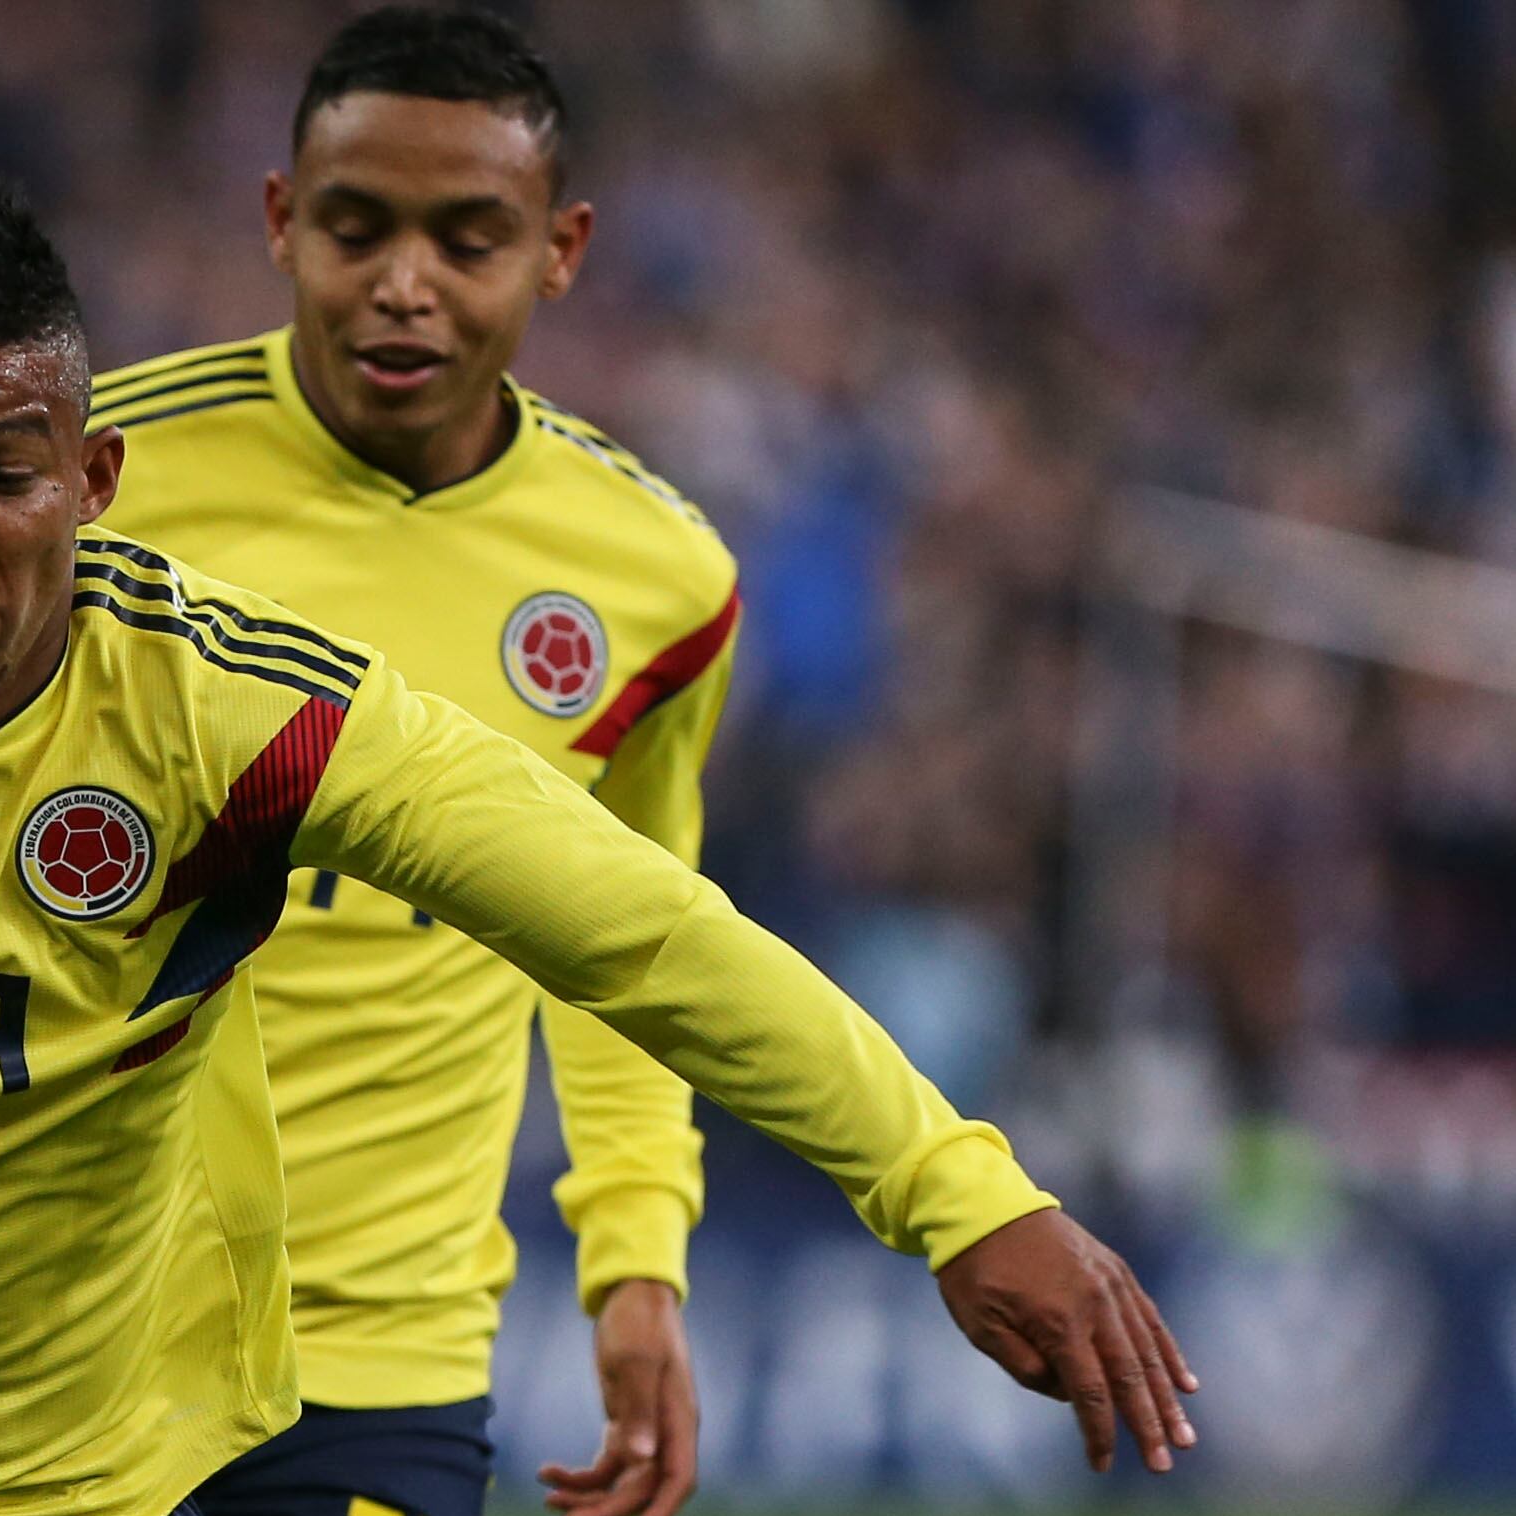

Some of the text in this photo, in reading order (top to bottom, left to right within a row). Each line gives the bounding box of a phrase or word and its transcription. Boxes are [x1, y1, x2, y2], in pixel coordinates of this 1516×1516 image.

[25, 793, 146, 858] FEDERACION COLOMBIANA DE FUTBOL
